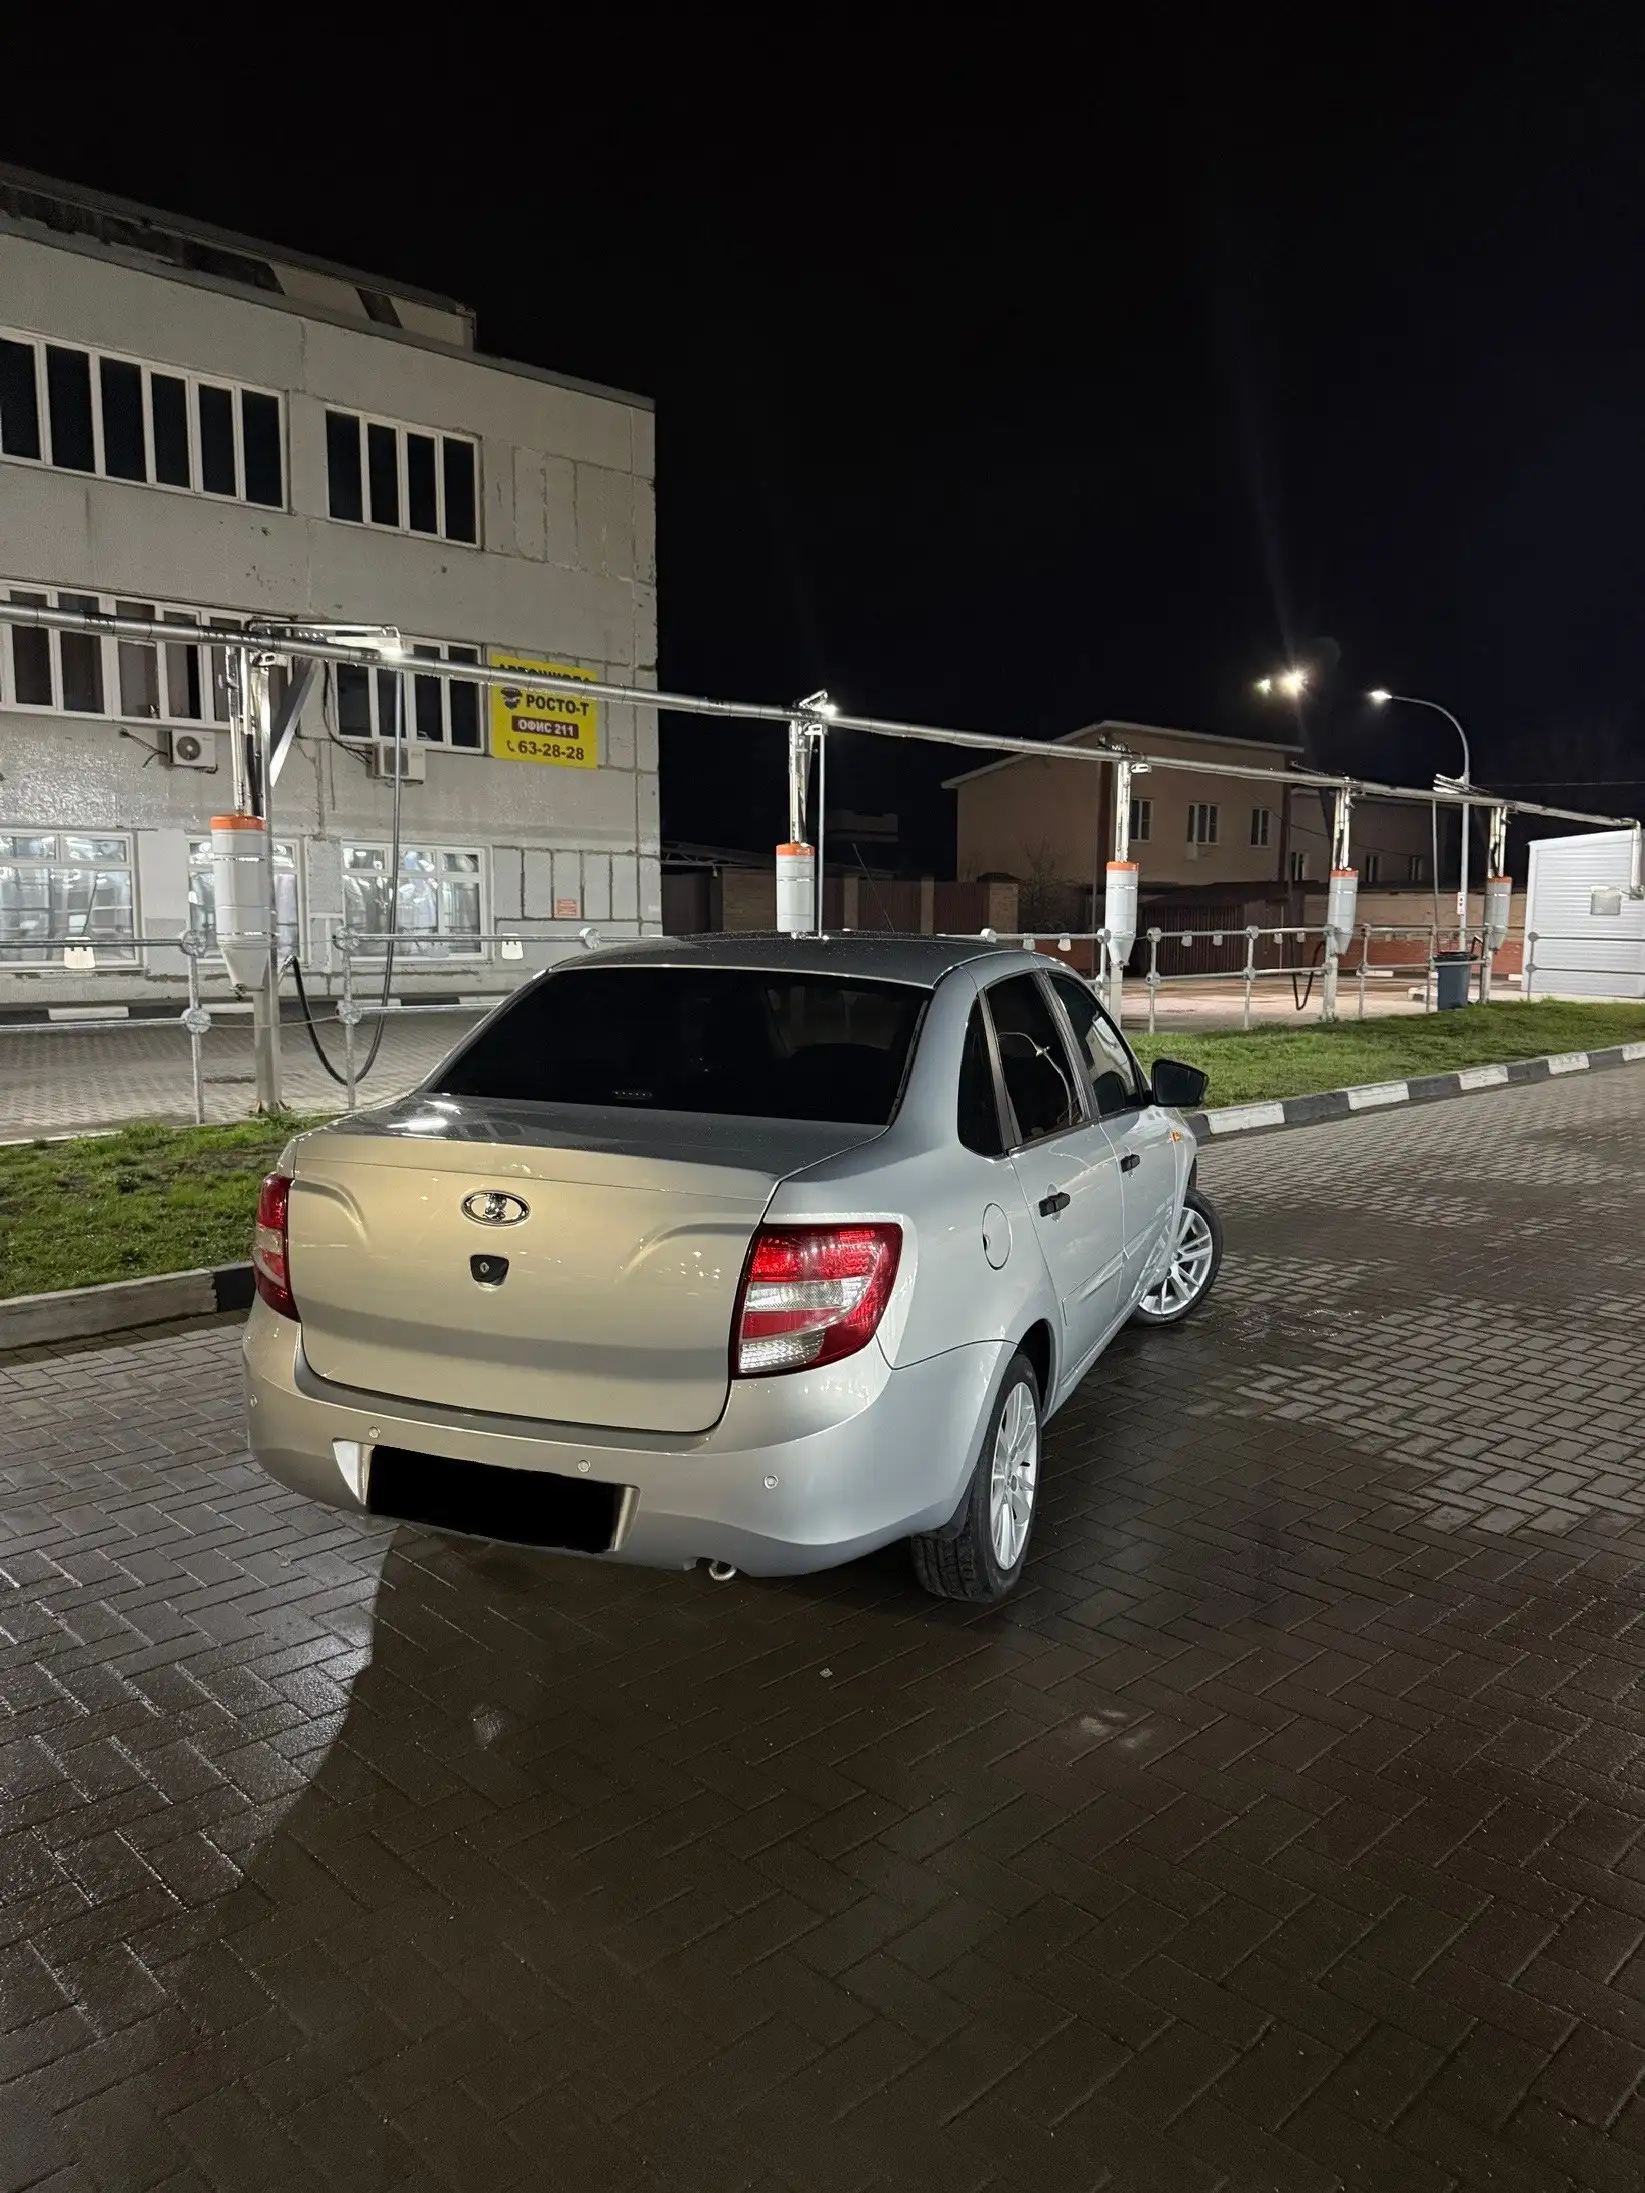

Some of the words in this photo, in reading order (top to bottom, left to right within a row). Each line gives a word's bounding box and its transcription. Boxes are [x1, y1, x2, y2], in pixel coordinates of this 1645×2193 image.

[526, 694, 589, 716] РОСТО-Т
[518, 719, 553, 734] ОФИС
[554, 723, 574, 737] 211
[518, 740, 584, 761] 63-28-28
